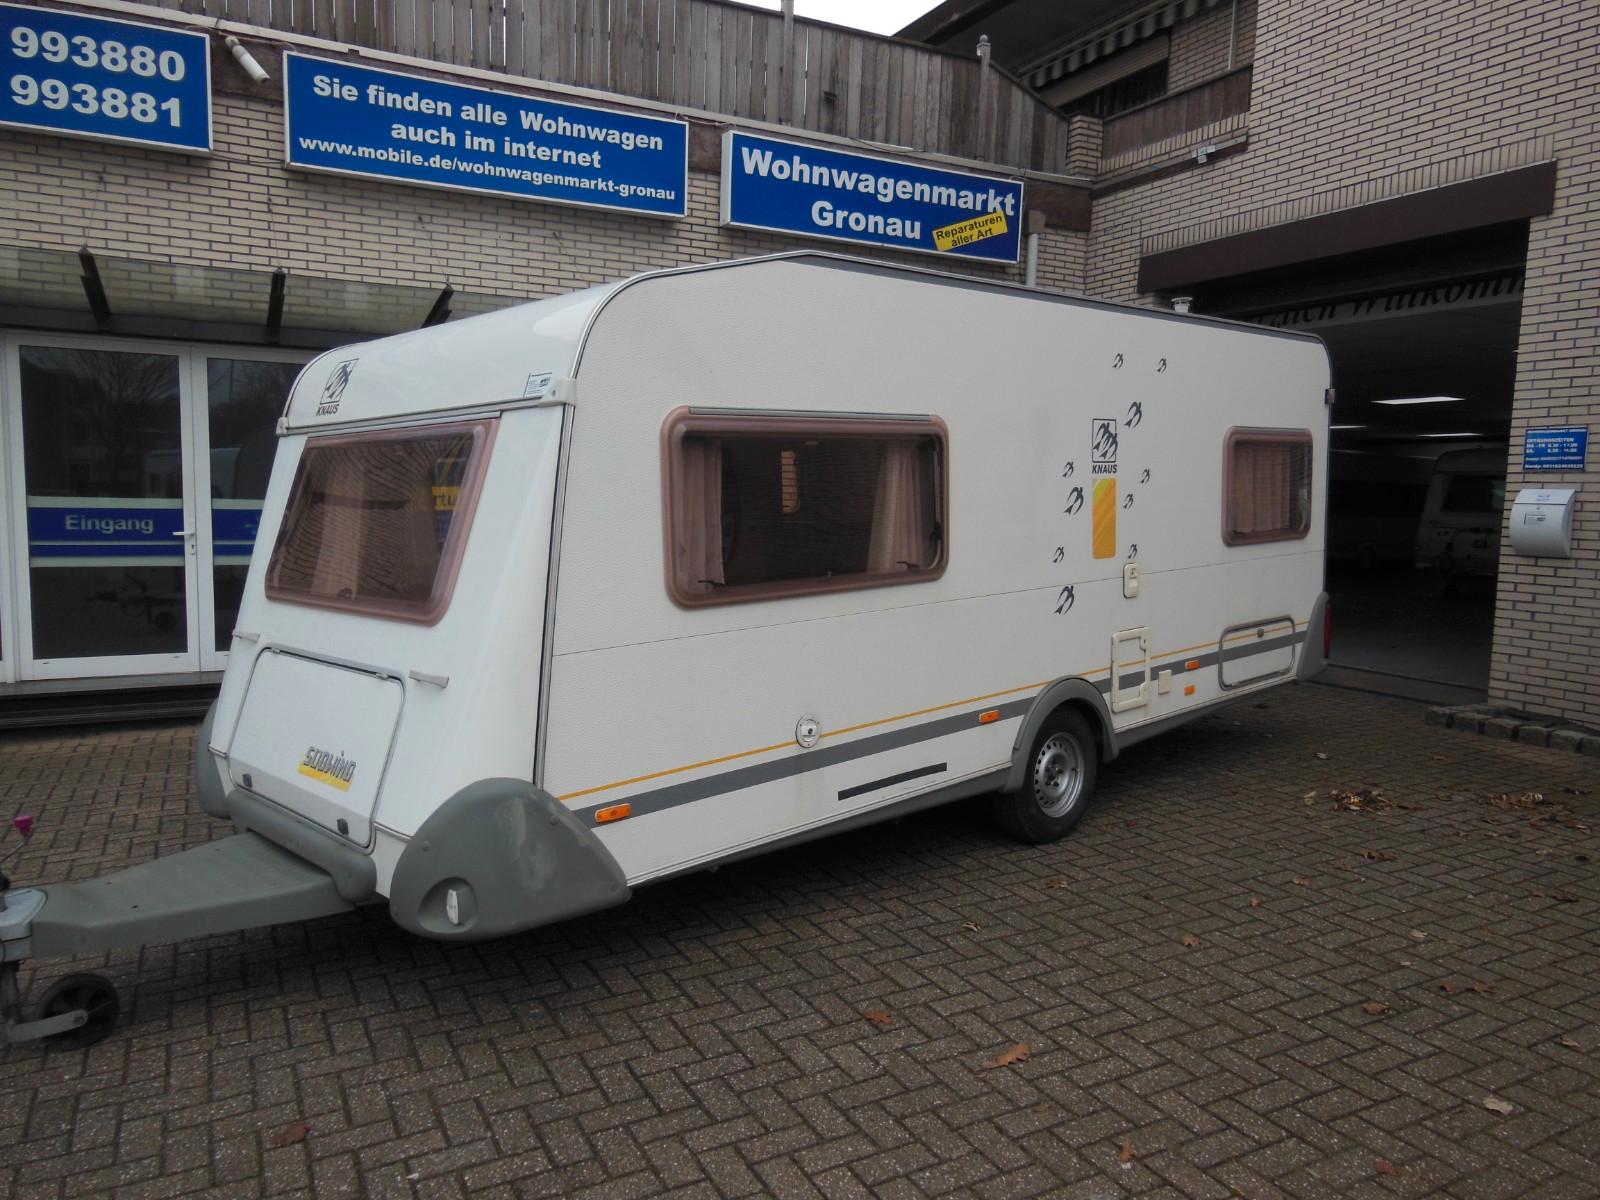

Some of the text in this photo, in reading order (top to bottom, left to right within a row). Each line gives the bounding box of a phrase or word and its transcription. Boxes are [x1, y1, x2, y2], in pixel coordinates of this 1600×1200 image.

[11, 26, 186, 81] 993880
[10, 74, 181, 127] 993881
[313, 75, 664, 151] Sie finden alle Wohnwagen
[391, 121, 602, 169] auch im internet
[299, 137, 676, 200] www.mobile.de/wohnwagenmarkt-gronau
[741, 146, 1016, 217] Wohnwagenmarkt
[811, 200, 921, 240] Gronau
[935, 215, 1003, 241] Reparaturen
[951, 227, 993, 247] aller Art
[316, 403, 340, 416] KNAUS
[1092, 464, 1117, 474] KNAUS
[65, 514, 154, 534] Eingang
